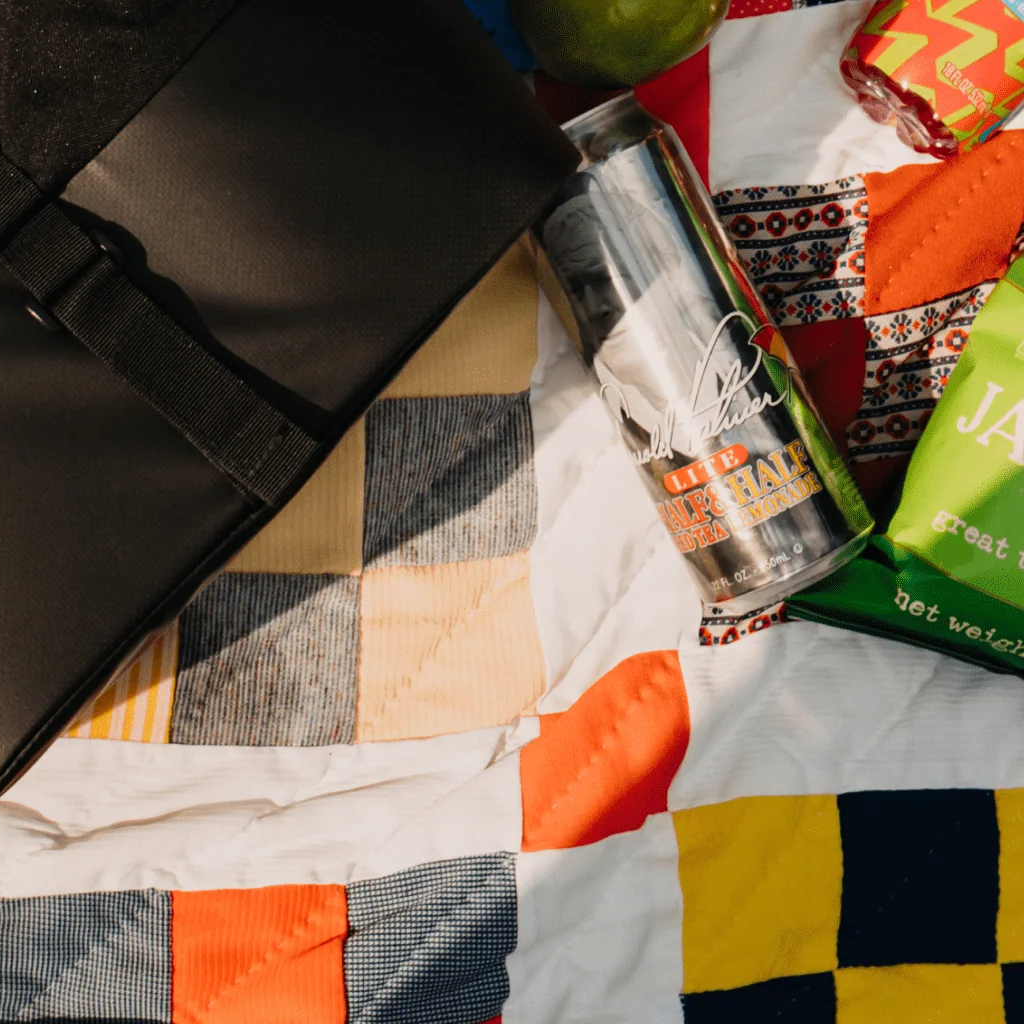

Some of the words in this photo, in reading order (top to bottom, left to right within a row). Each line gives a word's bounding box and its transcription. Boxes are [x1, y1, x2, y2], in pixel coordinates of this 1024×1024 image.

[671, 449, 740, 491] LITE
[724, 439, 811, 507] HALF
[690, 519, 730, 549] TEA
[728, 472, 823, 534] LEMONADE
[932, 510, 1010, 559] great
[894, 588, 940, 622] net
